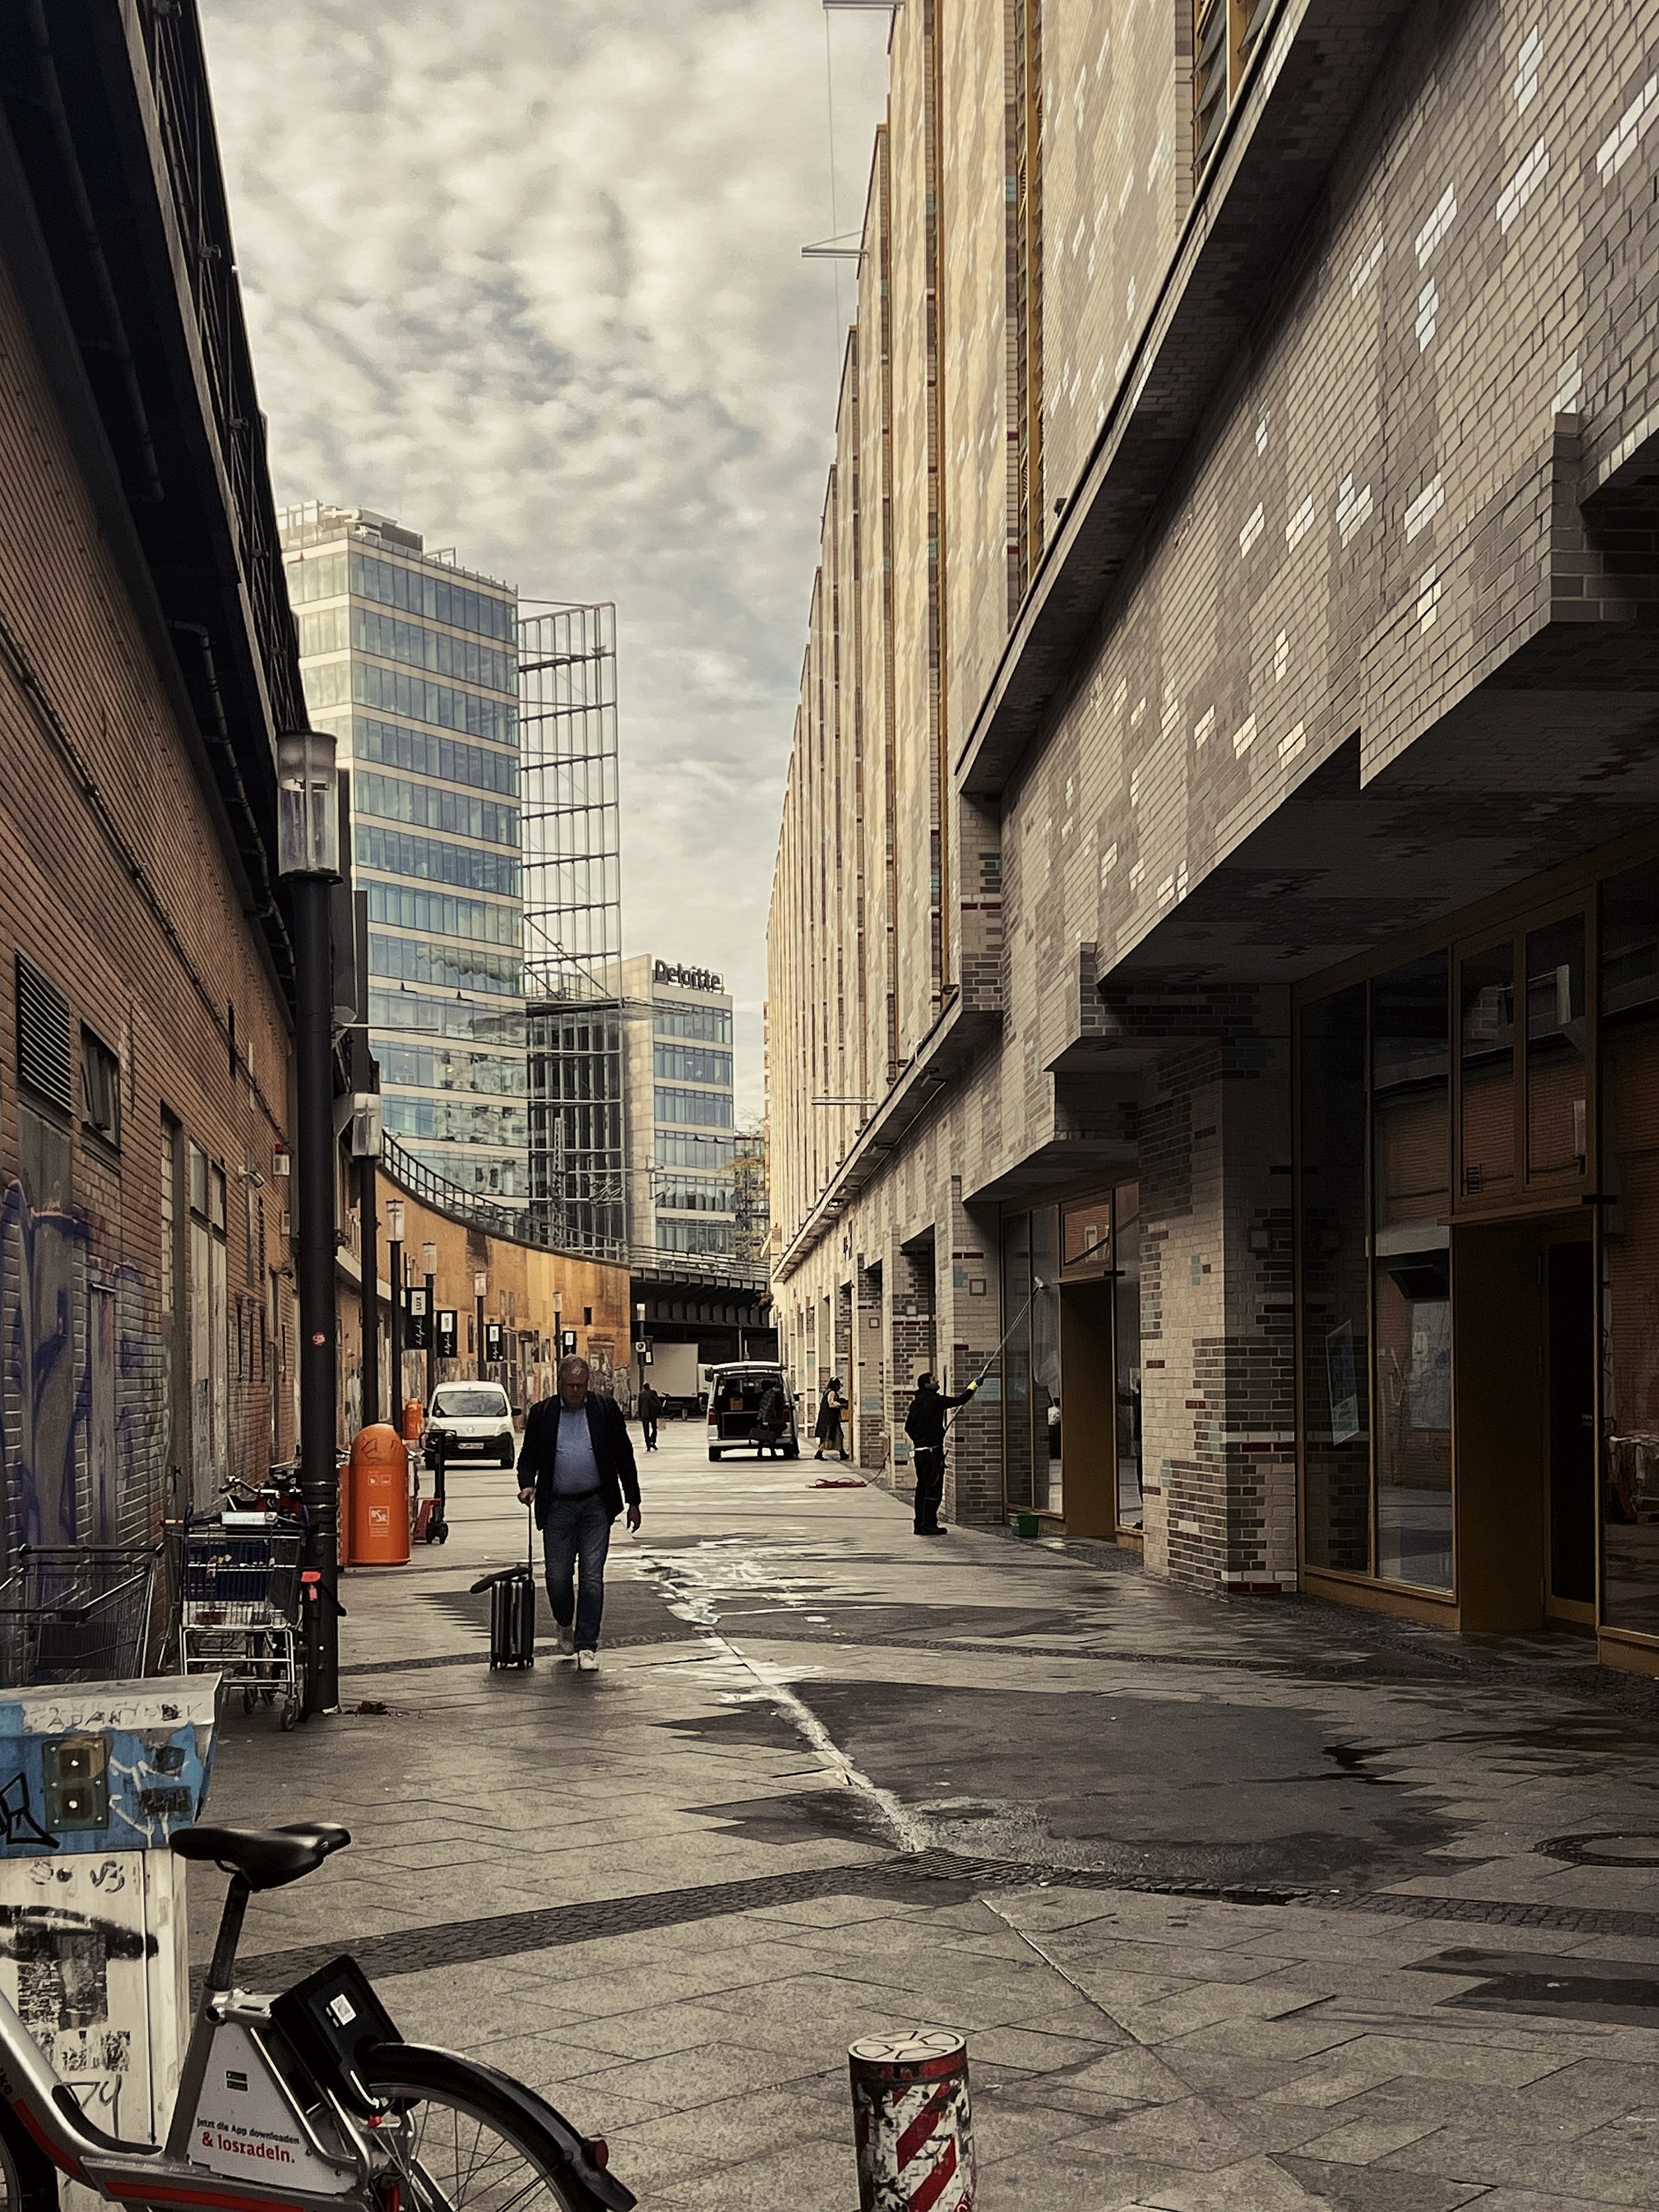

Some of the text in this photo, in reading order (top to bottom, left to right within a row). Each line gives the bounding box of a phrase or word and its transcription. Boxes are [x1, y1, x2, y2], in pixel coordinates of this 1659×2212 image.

[202, 2130, 295, 2164] & losradeln.
[216, 2122, 229, 2132] die
[231, 2124, 248, 2136] App
[249, 2127, 300, 2144] downloaden
